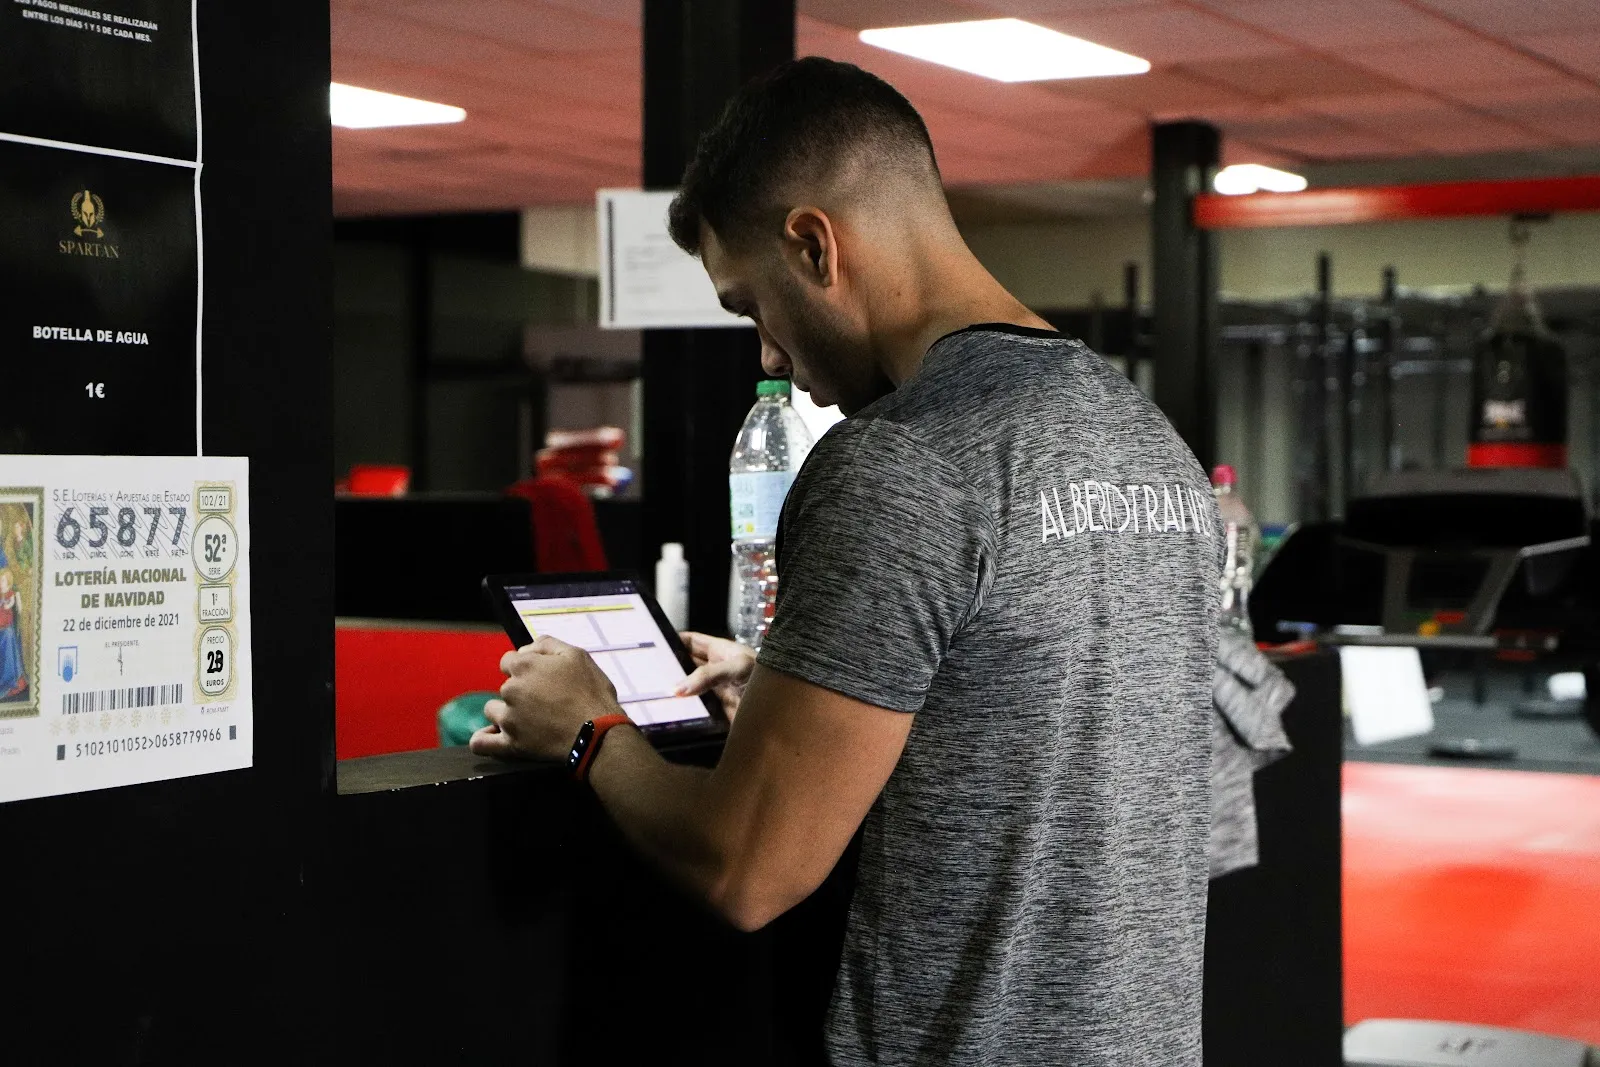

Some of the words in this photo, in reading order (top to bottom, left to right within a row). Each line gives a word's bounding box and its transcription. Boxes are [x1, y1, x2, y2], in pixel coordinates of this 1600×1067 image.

[22, 9, 49, 21] ENTRE
[50, 15, 64, 25] LOS
[65, 17, 82, 29] DÍAS
[84, 22, 88, 30] 1
[90, 23, 95, 31] Y
[96, 25, 101, 33] 5
[102, 26, 112, 35] DE
[113, 28, 134, 39] CADA
[135, 32, 152, 43] MES.
[59, 3, 101, 19] MENSUALES
[103, 13, 112, 21] SE
[113, 15, 158, 31] REALIZARÁN
[58, 239, 120, 259] SPARTAN
[33, 325, 93, 341] BOTELLA
[96, 329, 113, 343] DE
[116, 331, 149, 345] AGUA
[85, 382, 105, 398] 1€
[164, 490, 191, 503] ESTADO
[201, 494, 227, 508] 102/21
[56, 507, 188, 549] 65877
[54, 566, 117, 587] LOTERÍA
[121, 567, 187, 584] NACIONAL
[208, 567, 221, 576] SERIE
[80, 593, 100, 609] DE
[104, 590, 165, 608] NAVIDAD
[202, 608, 229, 617] FRACCIÓN
[62, 618, 76, 632] 22
[78, 617, 92, 631] de
[94, 614, 142, 630] diciembre
[144, 614, 156, 627] de
[158, 613, 180, 626] 2021
[206, 636, 225, 644] PRECIO
